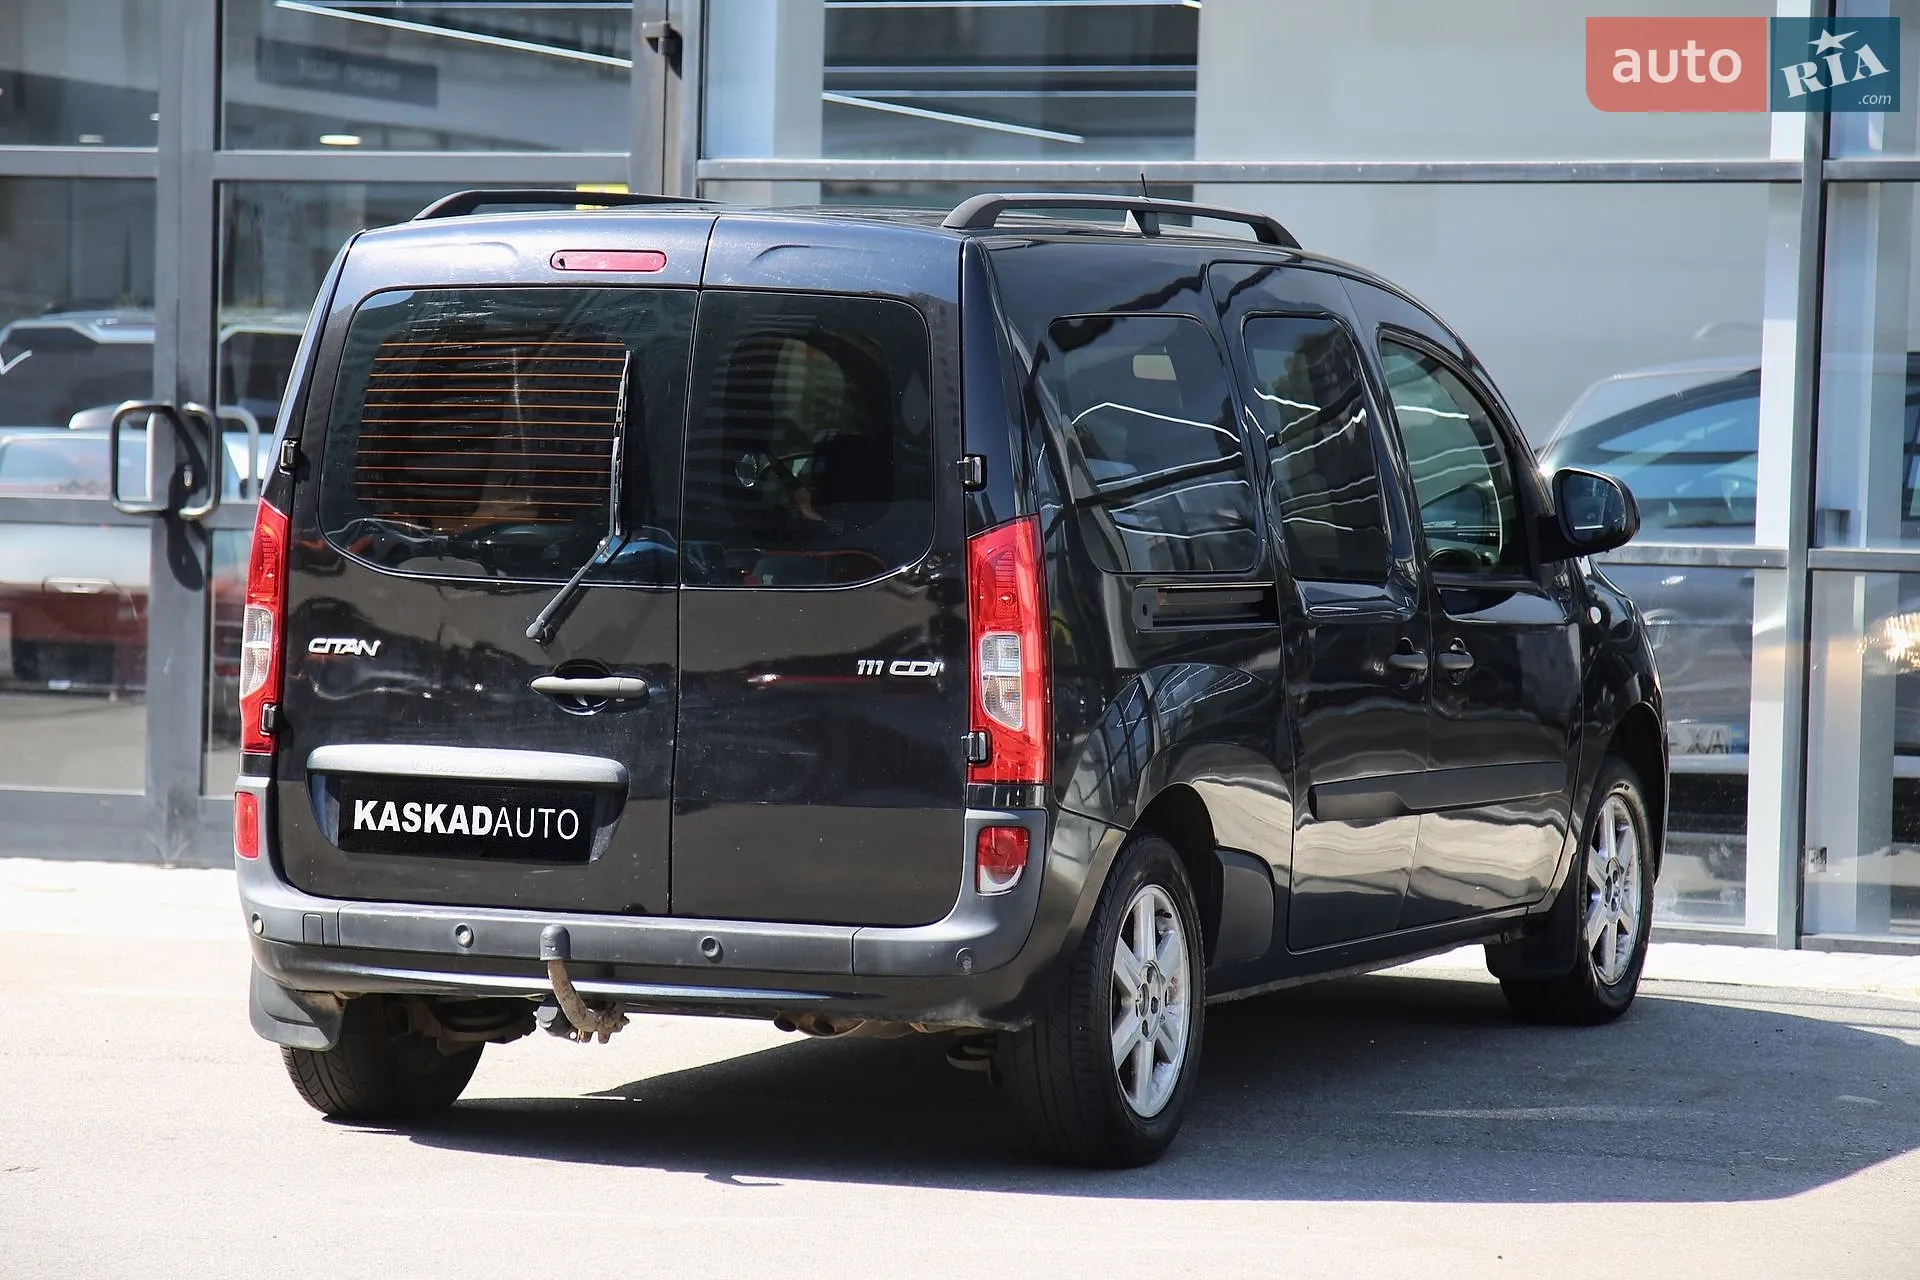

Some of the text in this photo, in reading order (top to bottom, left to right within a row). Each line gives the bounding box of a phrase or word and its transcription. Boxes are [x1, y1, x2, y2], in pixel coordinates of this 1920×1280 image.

[308, 637, 381, 657] CITAN
[857, 660, 940, 677] 111 CDI
[353, 799, 580, 840] KASKADAUTO
